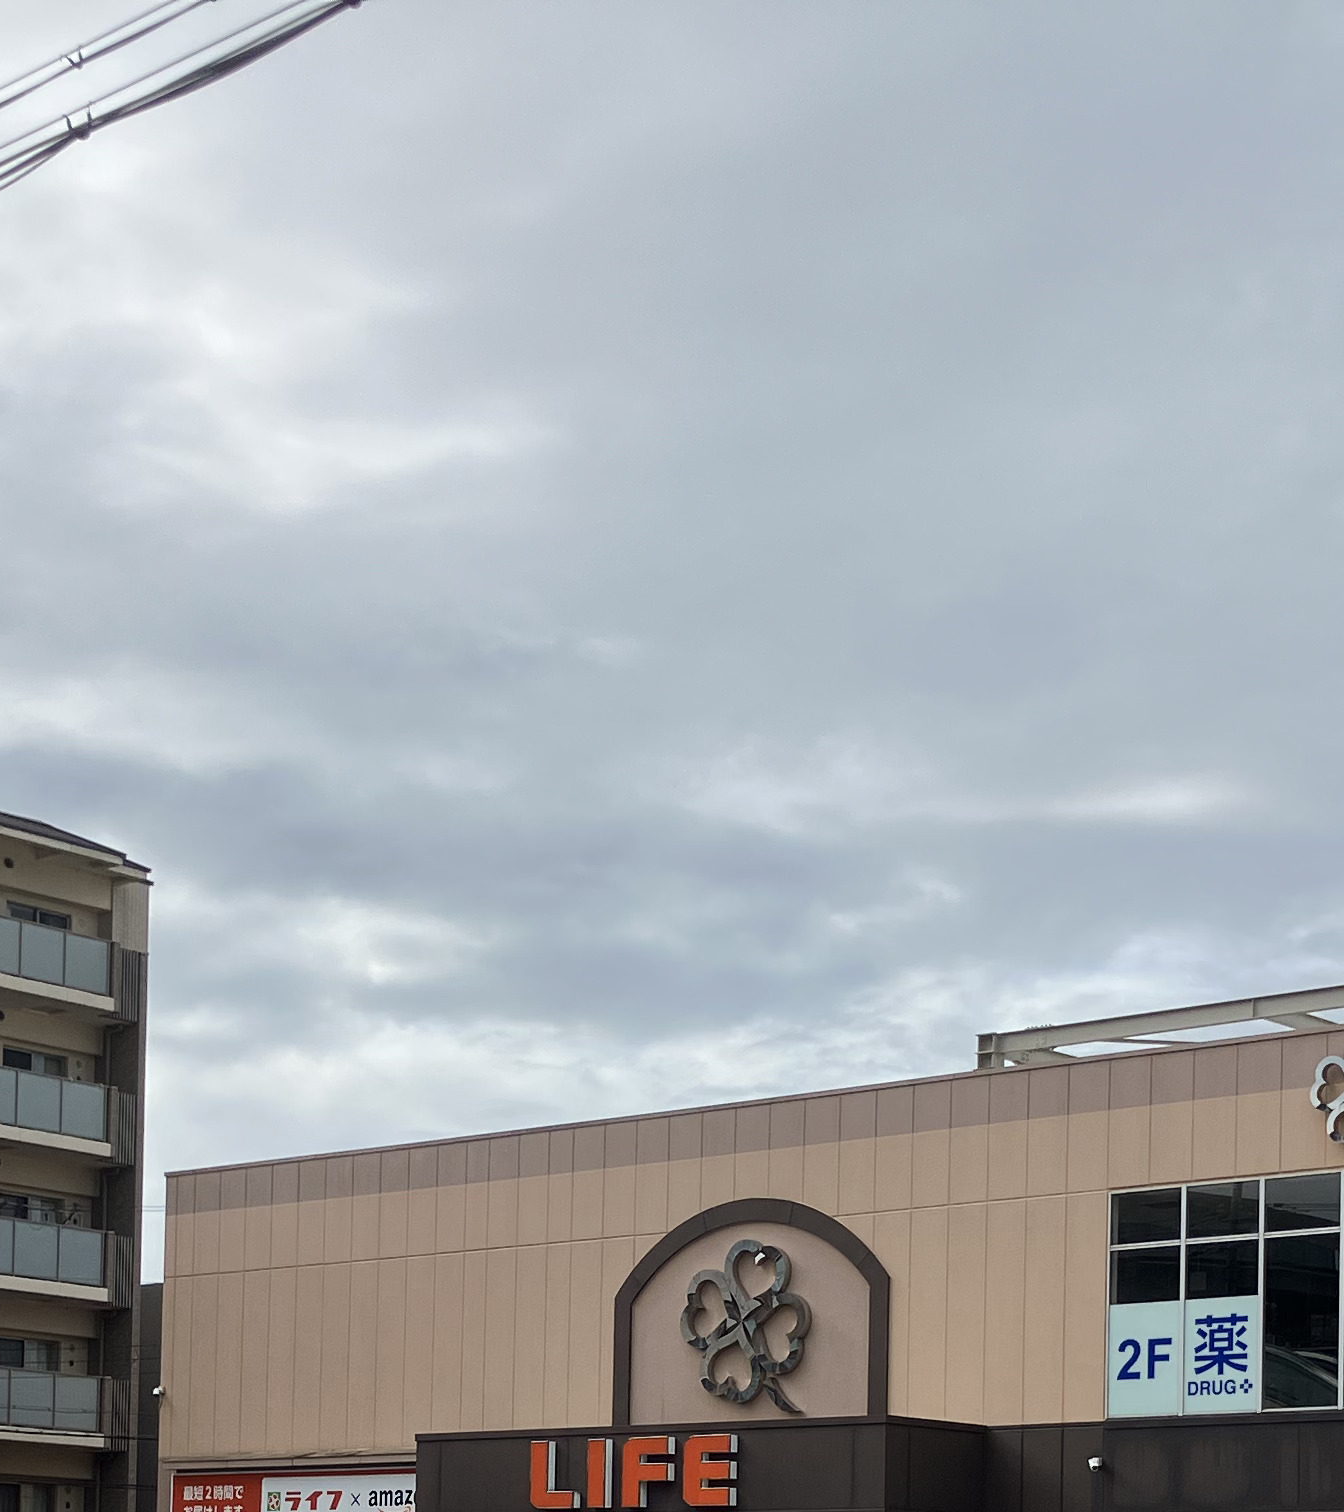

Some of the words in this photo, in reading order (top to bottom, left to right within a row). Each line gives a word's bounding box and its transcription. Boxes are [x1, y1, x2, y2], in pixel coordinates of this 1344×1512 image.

[1116, 1337, 1173, 1381] 2F
[1193, 1313, 1249, 1376] 薬
[1187, 1379, 1237, 1397] DRUG
[529, 1433, 739, 1510] LIFE
[182, 1485, 245, 1501] 最短2時間で
[284, 1490, 343, 1512] ライフ
[368, 1488, 417, 1507] amaz
